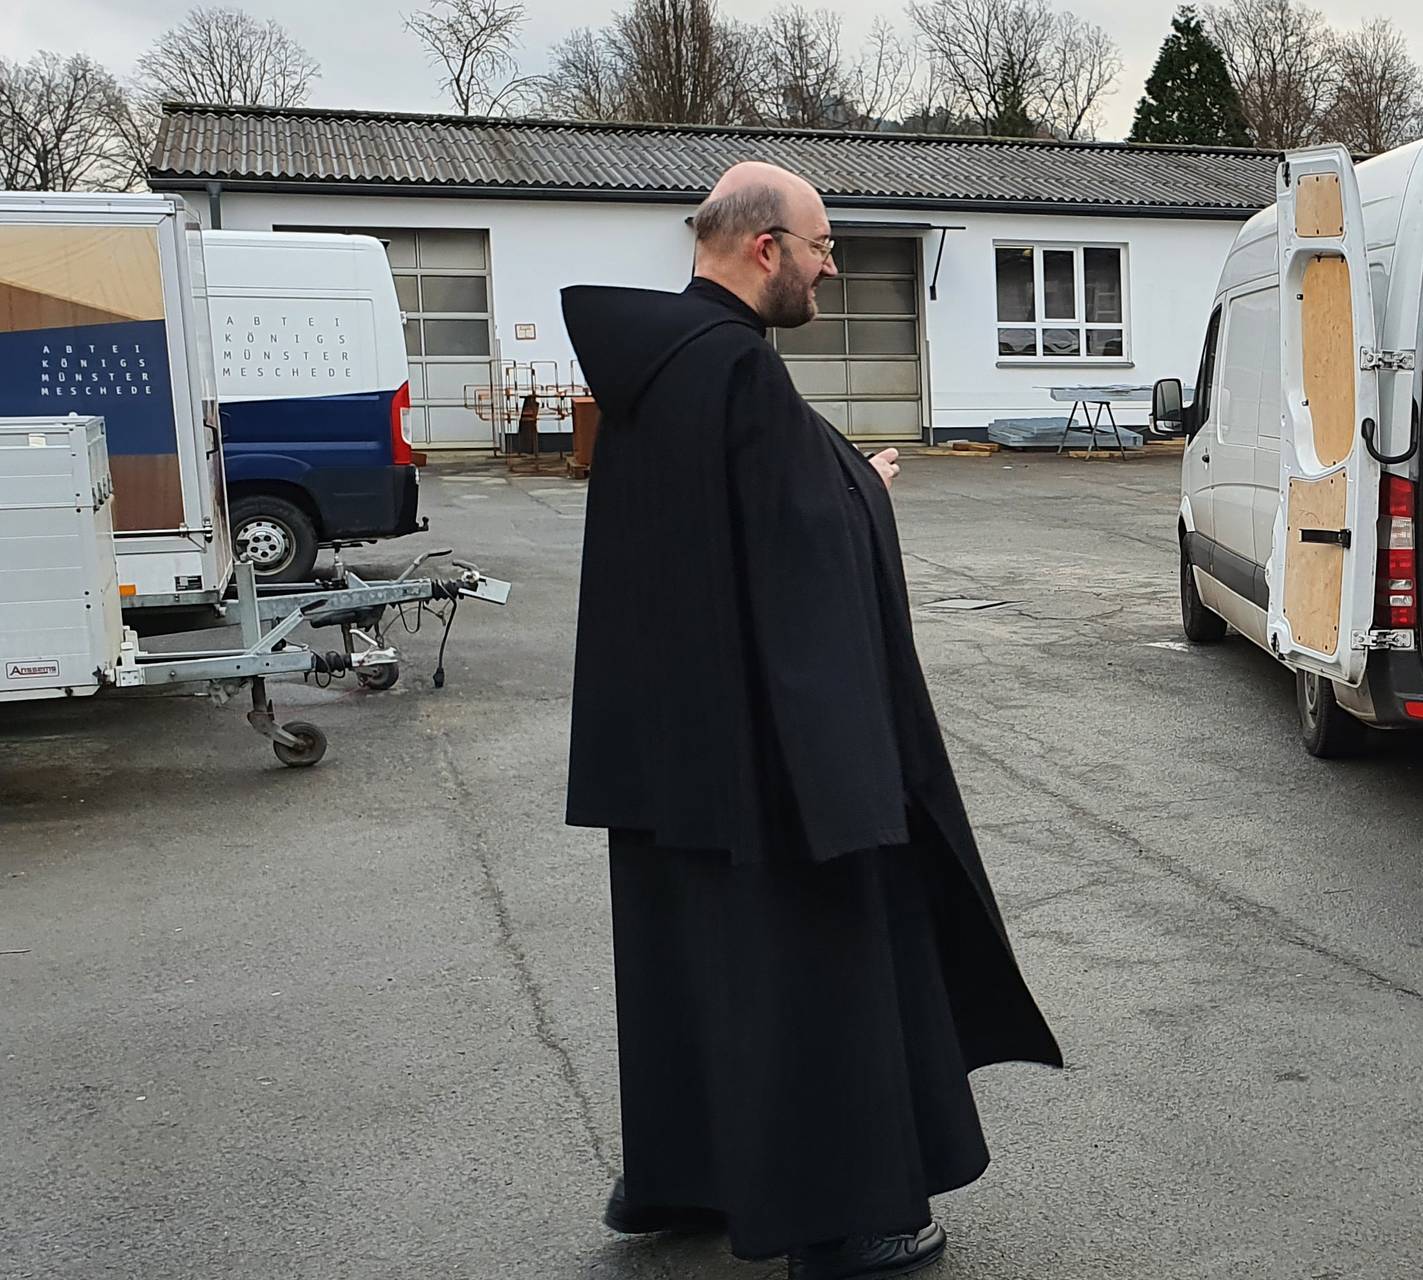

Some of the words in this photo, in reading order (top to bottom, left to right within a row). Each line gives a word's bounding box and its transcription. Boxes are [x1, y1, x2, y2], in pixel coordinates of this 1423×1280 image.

[225, 315, 341, 327] ABTEI
[224, 331, 346, 344] KÖNIGS
[42, 344, 141, 355] ABTEI
[222, 348, 349, 361] MÜNSTER
[41, 357, 146, 369] KÖNIGS
[41, 371, 149, 382] MÜNSTER
[221, 367, 351, 378] MESCHEDE
[40, 385, 152, 396] MESCHEDE
